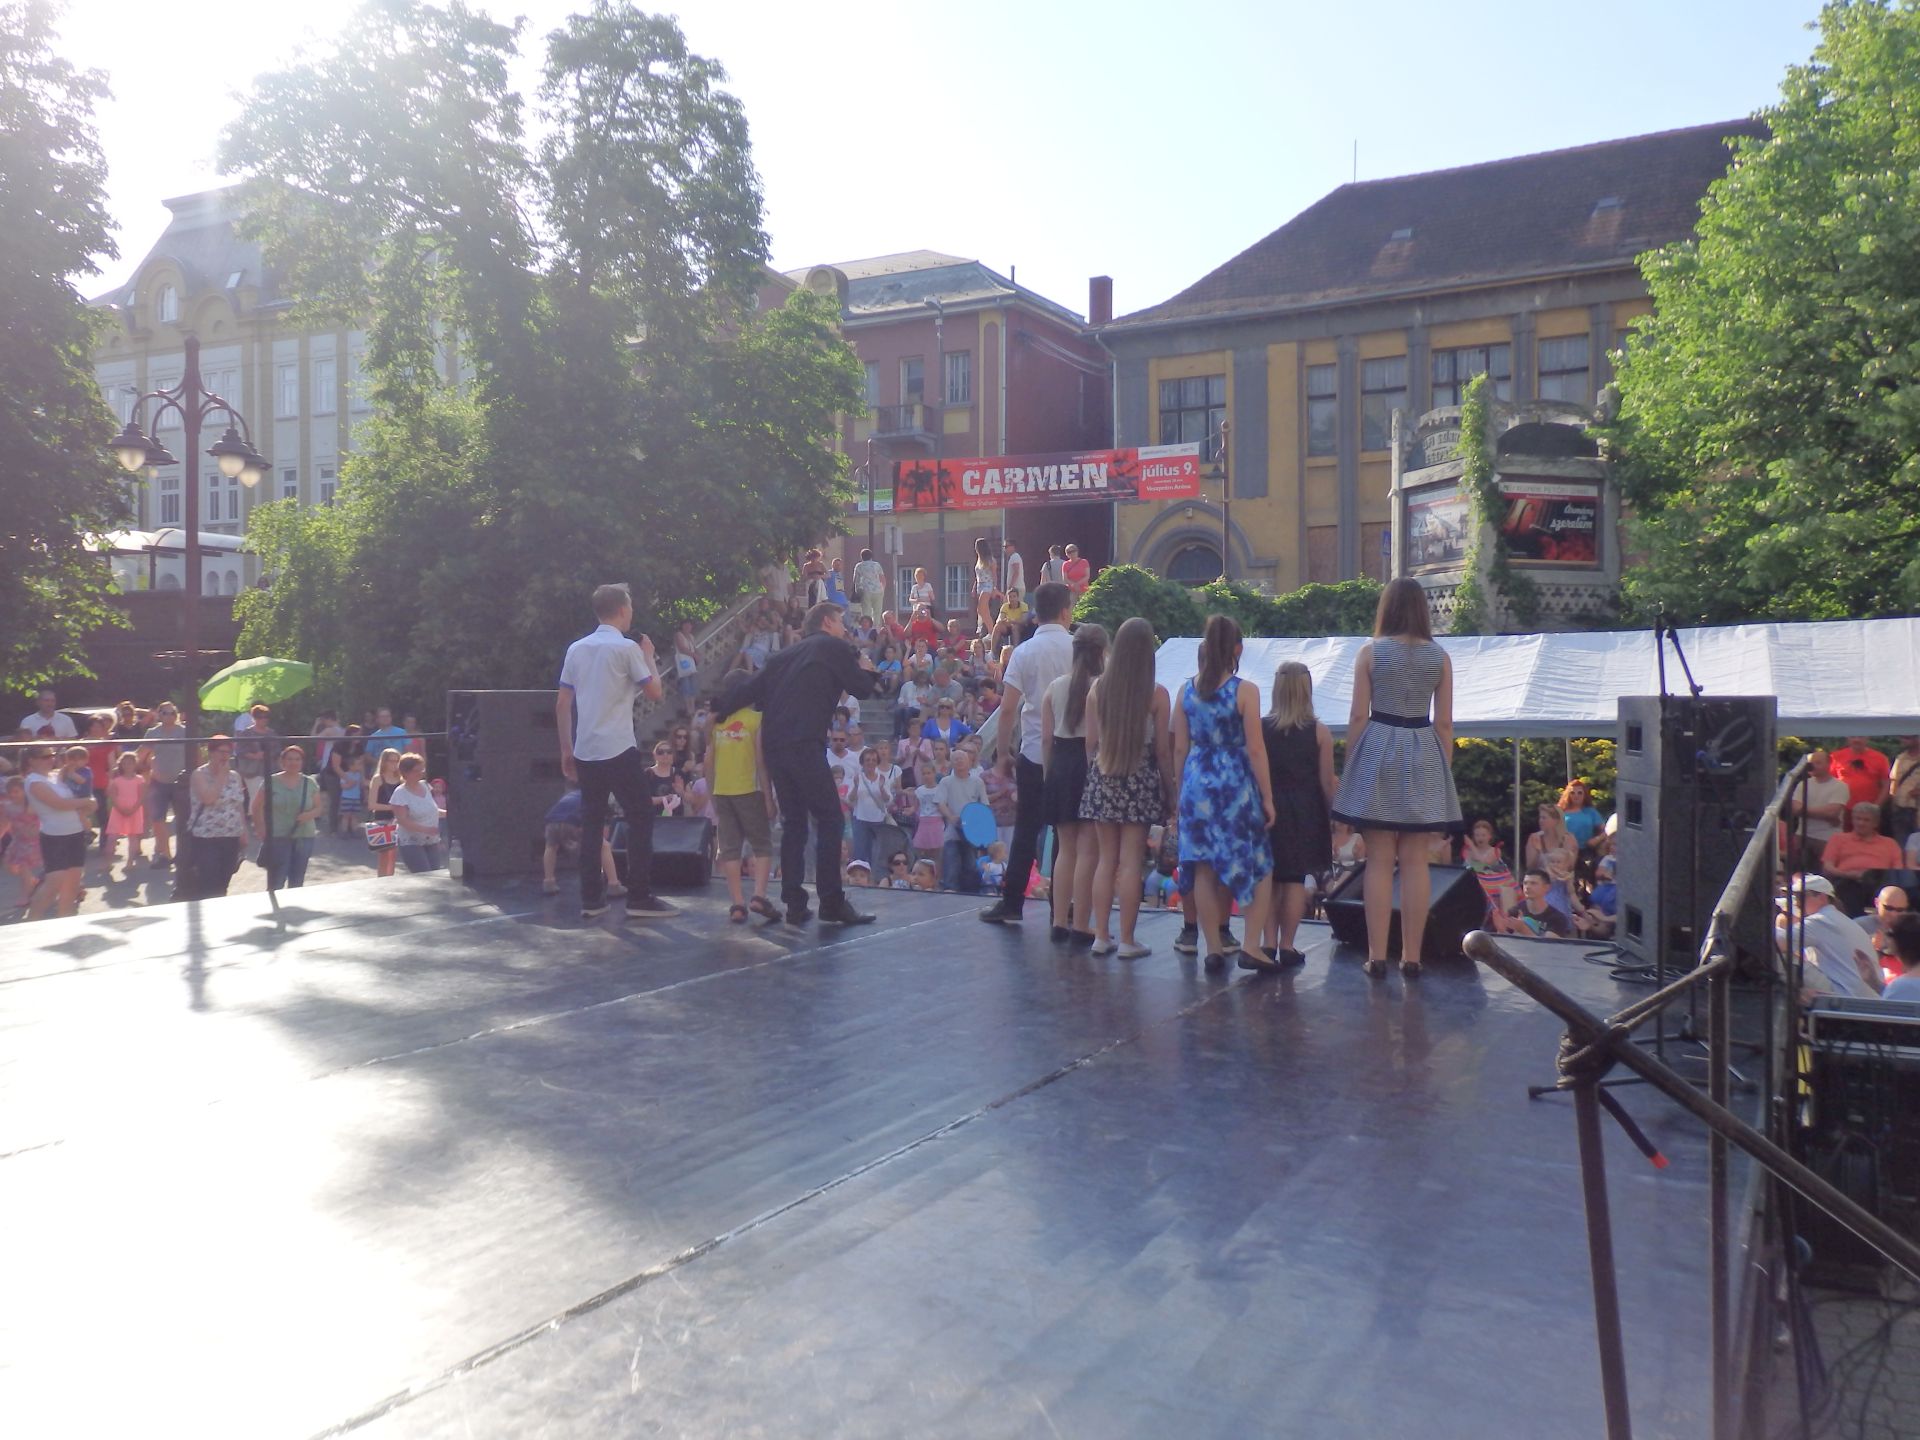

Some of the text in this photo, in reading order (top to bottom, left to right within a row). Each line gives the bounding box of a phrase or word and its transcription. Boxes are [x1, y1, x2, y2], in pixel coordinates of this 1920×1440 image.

[963, 463, 1108, 496] CARMEN
[1142, 461, 1197, 481] július 9.
